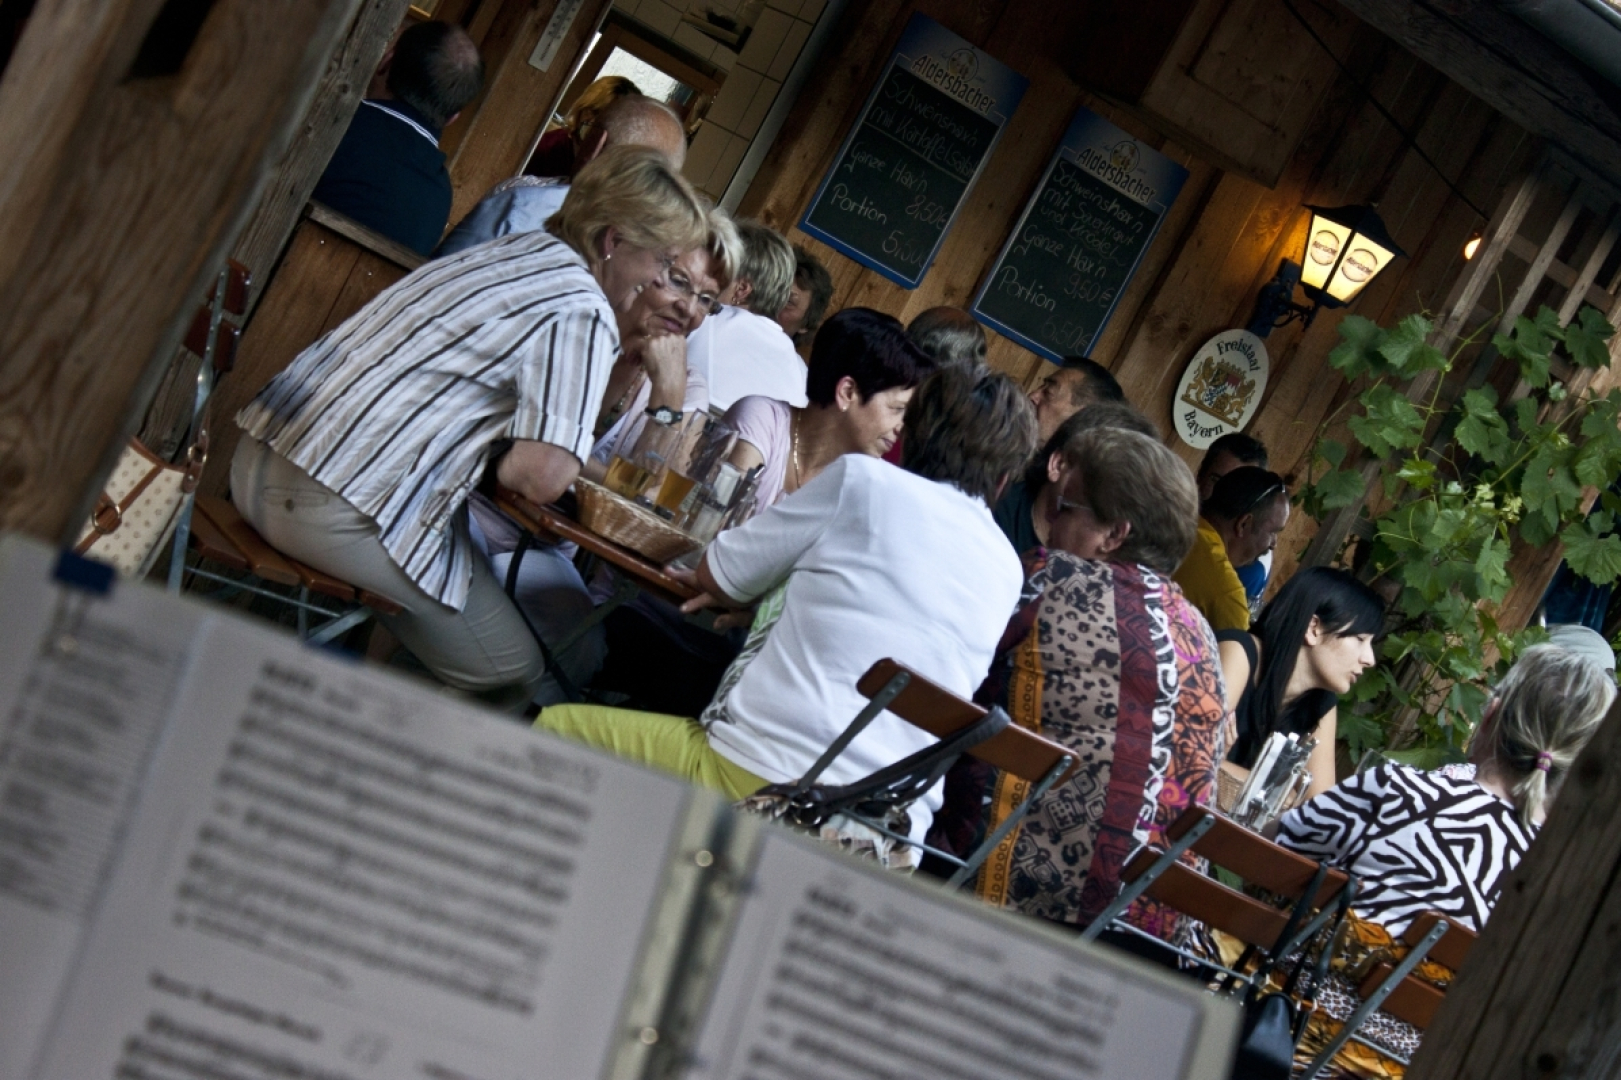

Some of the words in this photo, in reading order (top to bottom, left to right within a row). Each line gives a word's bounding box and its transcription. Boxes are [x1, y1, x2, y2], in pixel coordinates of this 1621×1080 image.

[912, 55, 996, 114] Aldersbacher
[869, 106, 897, 127] mit
[843, 142, 887, 173] Ganze
[889, 158, 928, 194] Hax'n
[1076, 148, 1156, 204] Aldersbacher
[830, 183, 887, 225] Portion
[1040, 206, 1068, 225] und
[1043, 188, 1073, 209] mit
[882, 230, 925, 268] 5,50
[1014, 225, 1065, 257] Ganze
[1066, 244, 1107, 278] Hax'n
[997, 265, 1056, 312] Portion
[1216, 338, 1261, 372] Freistaat
[1184, 409, 1224, 438] Bayern
